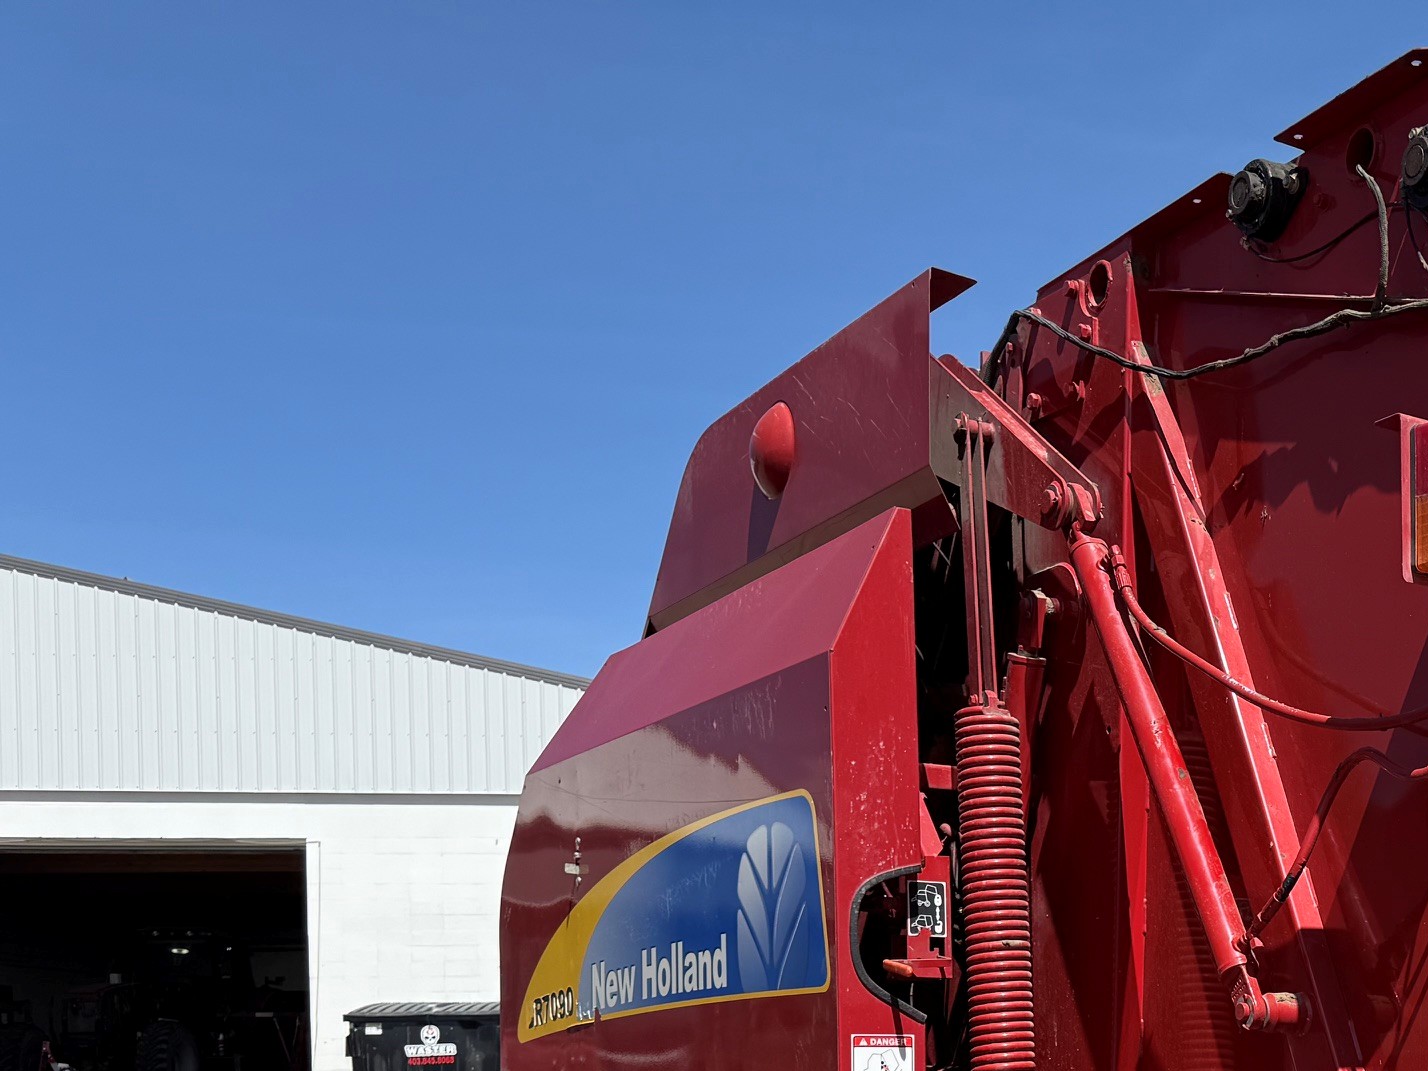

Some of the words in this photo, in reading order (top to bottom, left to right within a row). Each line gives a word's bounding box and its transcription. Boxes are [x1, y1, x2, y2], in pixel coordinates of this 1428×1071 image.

[592, 961, 636, 1011] New
[641, 932, 728, 1000] Holland
[529, 987, 574, 1029] R7090
[870, 1038, 906, 1046] DANGER
